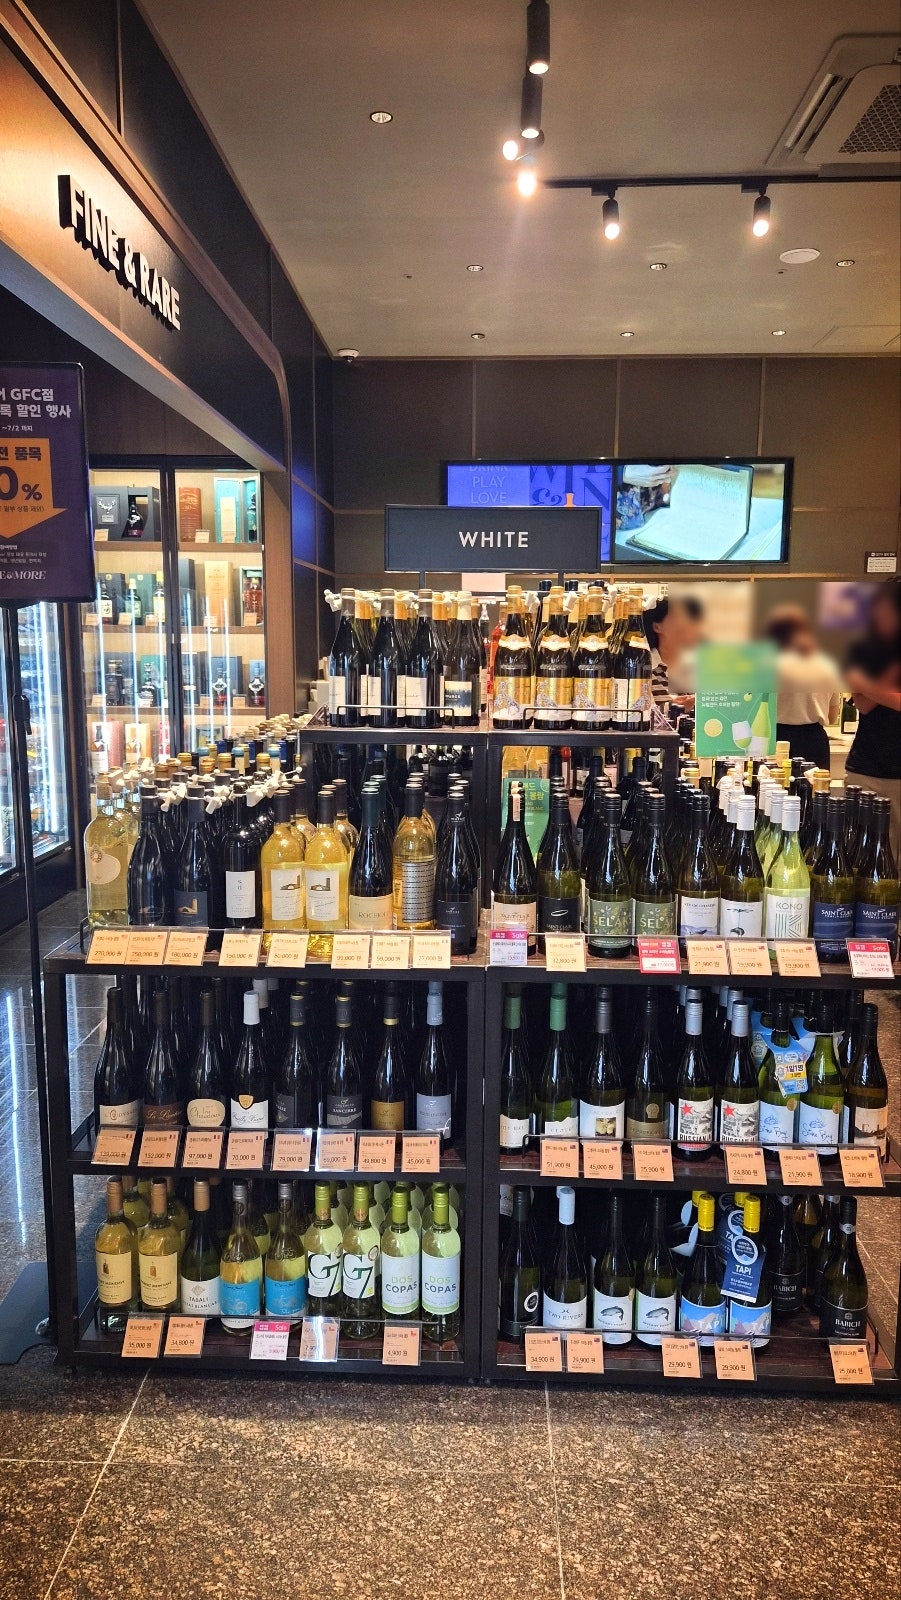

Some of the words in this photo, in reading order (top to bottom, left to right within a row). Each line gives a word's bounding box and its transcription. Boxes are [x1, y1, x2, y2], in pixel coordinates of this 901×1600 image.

[58, 174, 121, 273] FINE
[134, 252, 181, 332] RARE
[10, 387, 54, 402] GFC점
[16, 403, 42, 418] 할인
[45, 404, 72, 419] 행사
[14, 446, 42, 462] 품목
[472, 476, 504, 488] PLAY
[471, 491, 507, 504] LOVE
[459, 532, 529, 548] WHITE
[776, 902, 803, 910] KONO
[232, 1154, 249, 1162] 70,000
[308, 1253, 341, 1297] G7
[343, 1252, 374, 1298] G7
[735, 1264, 752, 1275] TAPI
[391, 1275, 413, 1284] DOS
[429, 1275, 451, 1284] DOS
[385, 1281, 418, 1293] COPAS
[424, 1283, 457, 1294] COPAS
[547, 1310, 562, 1319] TWO
[835, 1318, 861, 1328] BABICH
[387, 1349, 401, 1357] 4,900
